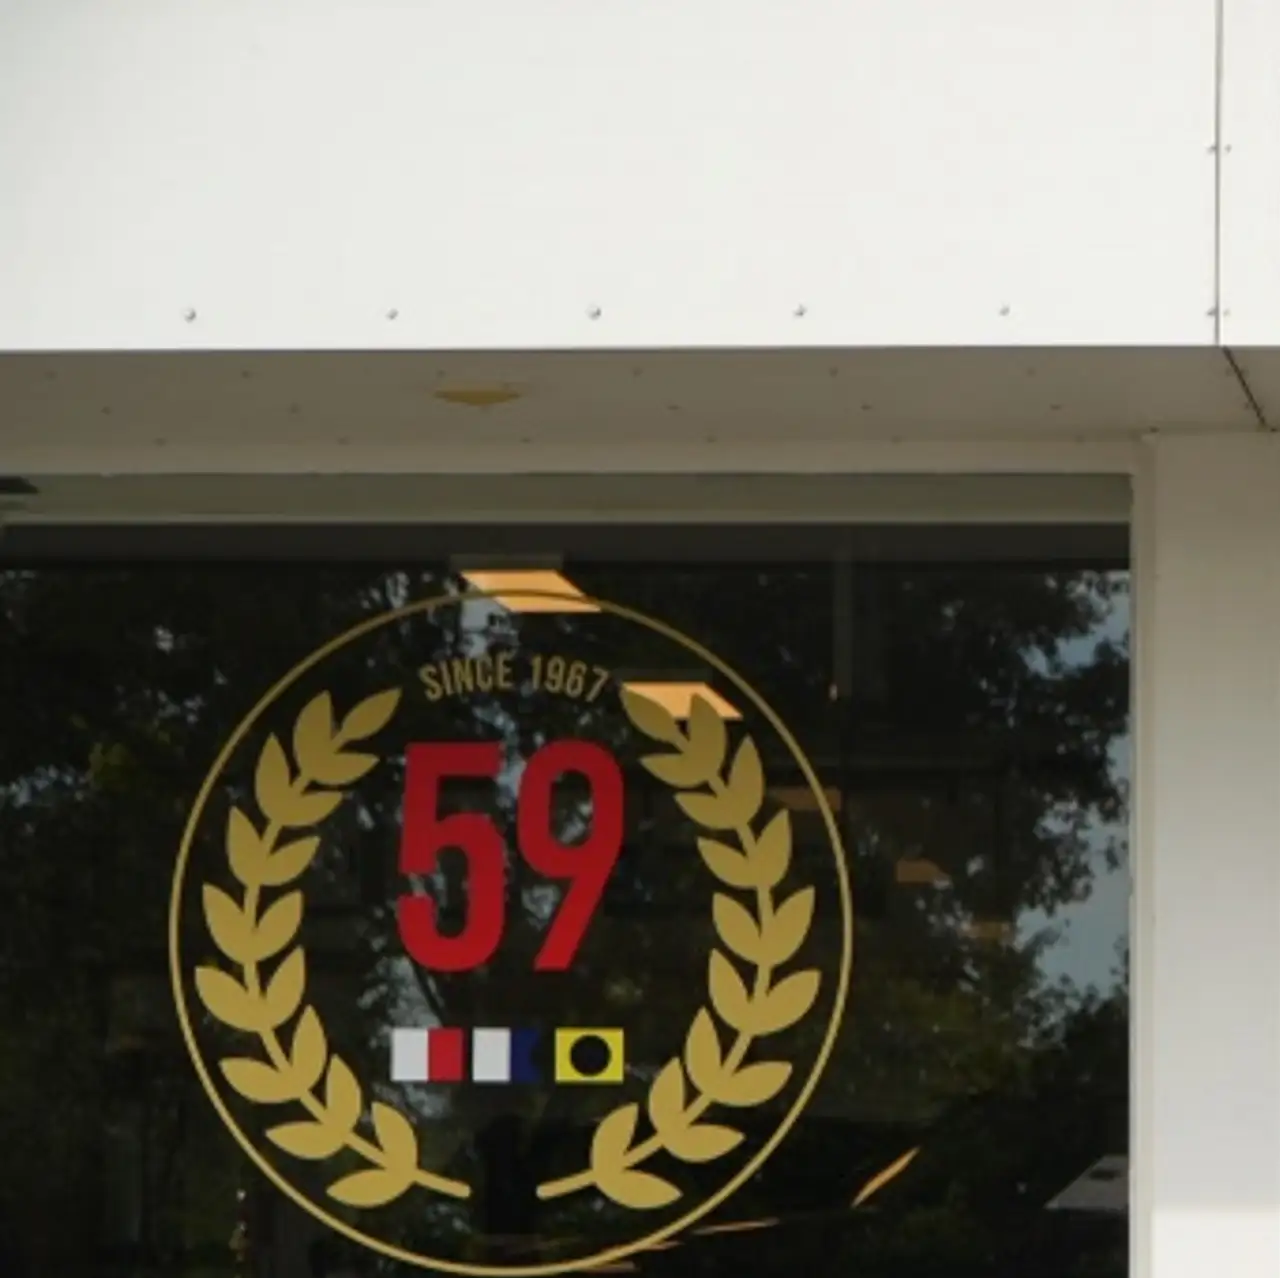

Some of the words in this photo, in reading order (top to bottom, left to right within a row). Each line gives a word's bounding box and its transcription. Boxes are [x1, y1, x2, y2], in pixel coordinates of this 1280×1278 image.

[418, 651, 515, 702] SINCE
[531, 655, 612, 702] 1967
[397, 740, 625, 973] 59
